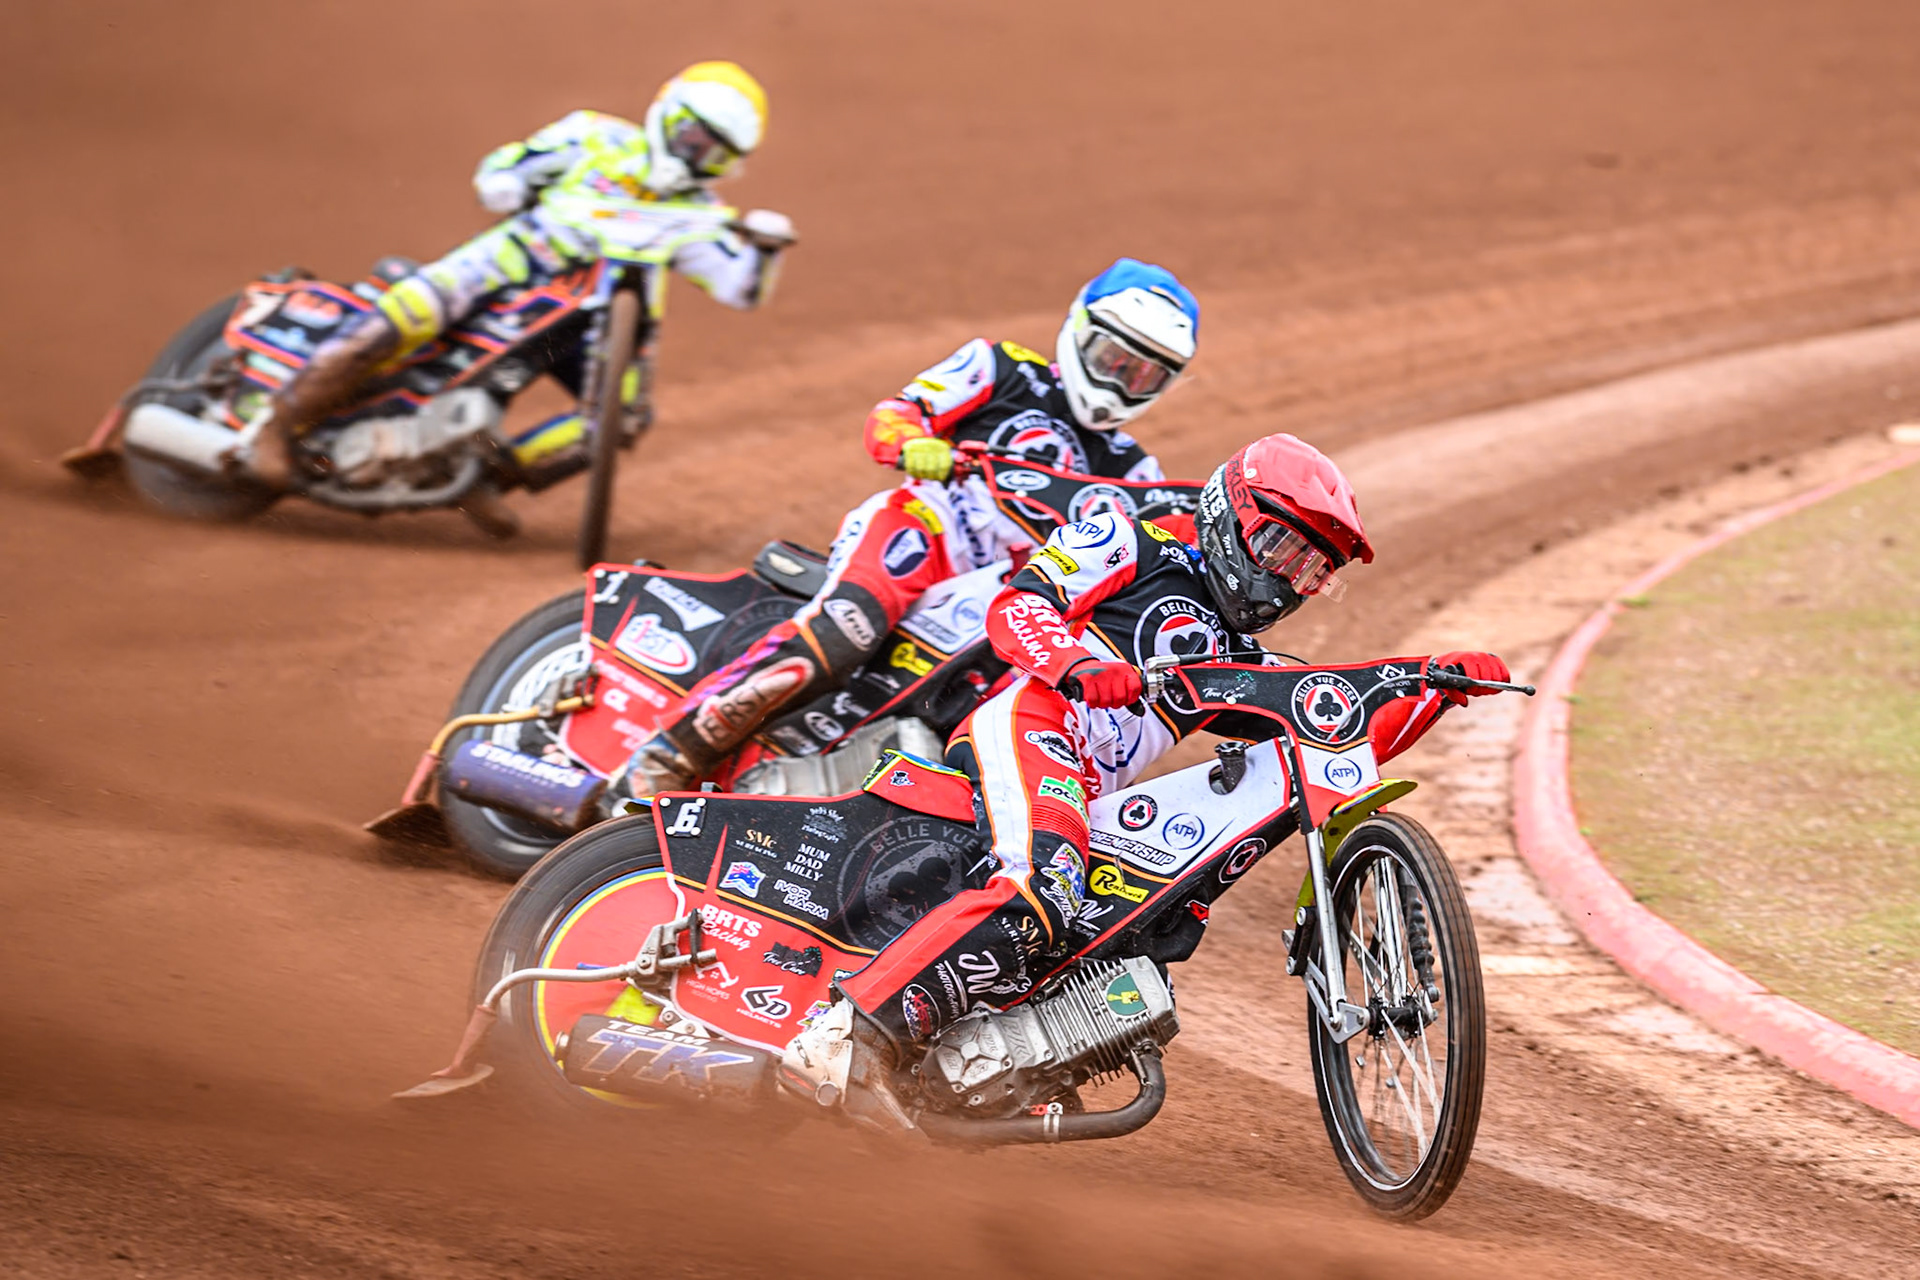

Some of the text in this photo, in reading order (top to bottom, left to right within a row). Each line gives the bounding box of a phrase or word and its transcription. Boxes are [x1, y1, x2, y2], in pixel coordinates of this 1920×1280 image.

[1067, 521, 1104, 539] ATPI
[1158, 601, 1198, 618] BELLE
[998, 598, 1051, 668] Racing
[1295, 676, 1357, 703] BELLE VUE ACES
[1332, 767, 1356, 778] ATPI
[674, 802, 702, 833] 6
[870, 823, 980, 853] BELLE VUE
[1168, 823, 1198, 841] ATPI
[794, 854, 823, 870] DAD
[798, 843, 831, 862] MUM
[783, 861, 824, 882] MILLY
[773, 879, 812, 901] IVOR
[783, 893, 829, 920] HARM
[701, 903, 763, 938] BRTS
[700, 920, 752, 952] Racing
[741, 985, 792, 1020] 6D
[736, 1007, 783, 1030] HELMETS
[607, 1020, 711, 1047] TEAM
